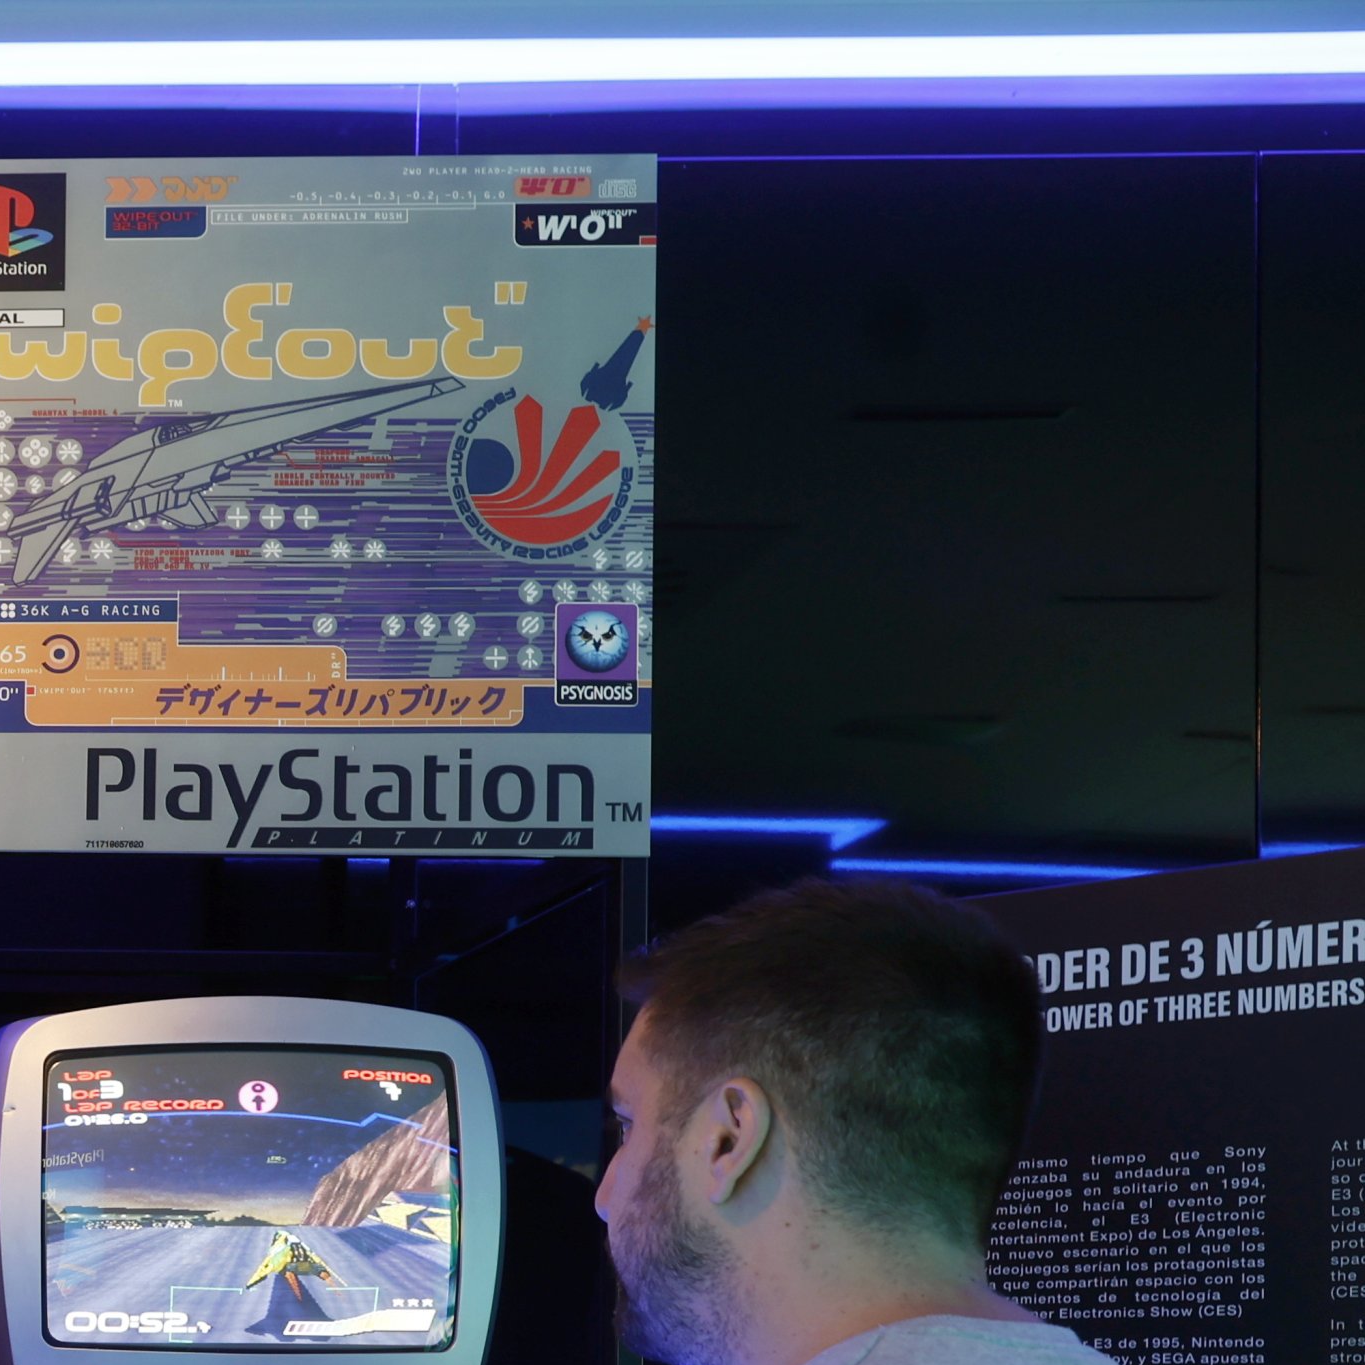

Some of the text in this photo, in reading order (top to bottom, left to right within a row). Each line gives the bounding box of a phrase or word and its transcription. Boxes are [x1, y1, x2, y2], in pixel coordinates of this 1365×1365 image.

[429, 167, 467, 176] PLAYER
[553, 165, 592, 174] RACING
[216, 210, 403, 222] FILE UNDER: ADRENALIN RUSH
[21, 604, 161, 616] 36K A-G RACING
[0, 645, 27, 663] 65
[560, 685, 633, 701] PSYGNOSIS
[1121, 939, 1171, 987] DE
[1180, 937, 1205, 980] 3
[1039, 977, 1365, 1033] OWER OF THREE NUMBERS
[342, 1068, 433, 1085] POSITION
[123, 1098, 225, 1112] RECORD
[1331, 1139, 1349, 1151] At
[1018, 1146, 1267, 1170] mismo tiempo que Sony
[1081, 1161, 1267, 1182] su andadura en los
[1055, 1193, 1267, 1214] lo hacía el evento por
[1331, 1204, 1361, 1217] Los
[1091, 1209, 1266, 1227] el E3 (Electronic
[1089, 1223, 1266, 1244] Expo) de Los Ángeles.
[1074, 1256, 1266, 1274] serían los protagonistas
[1330, 1270, 1357, 1282] the
[1058, 1303, 1243, 1319] Electronics Show (CES)
[1093, 1336, 1265, 1350] E3 de 1995, Nintendo
[1151, 1352, 1265, 1365] SEGA apuesta
